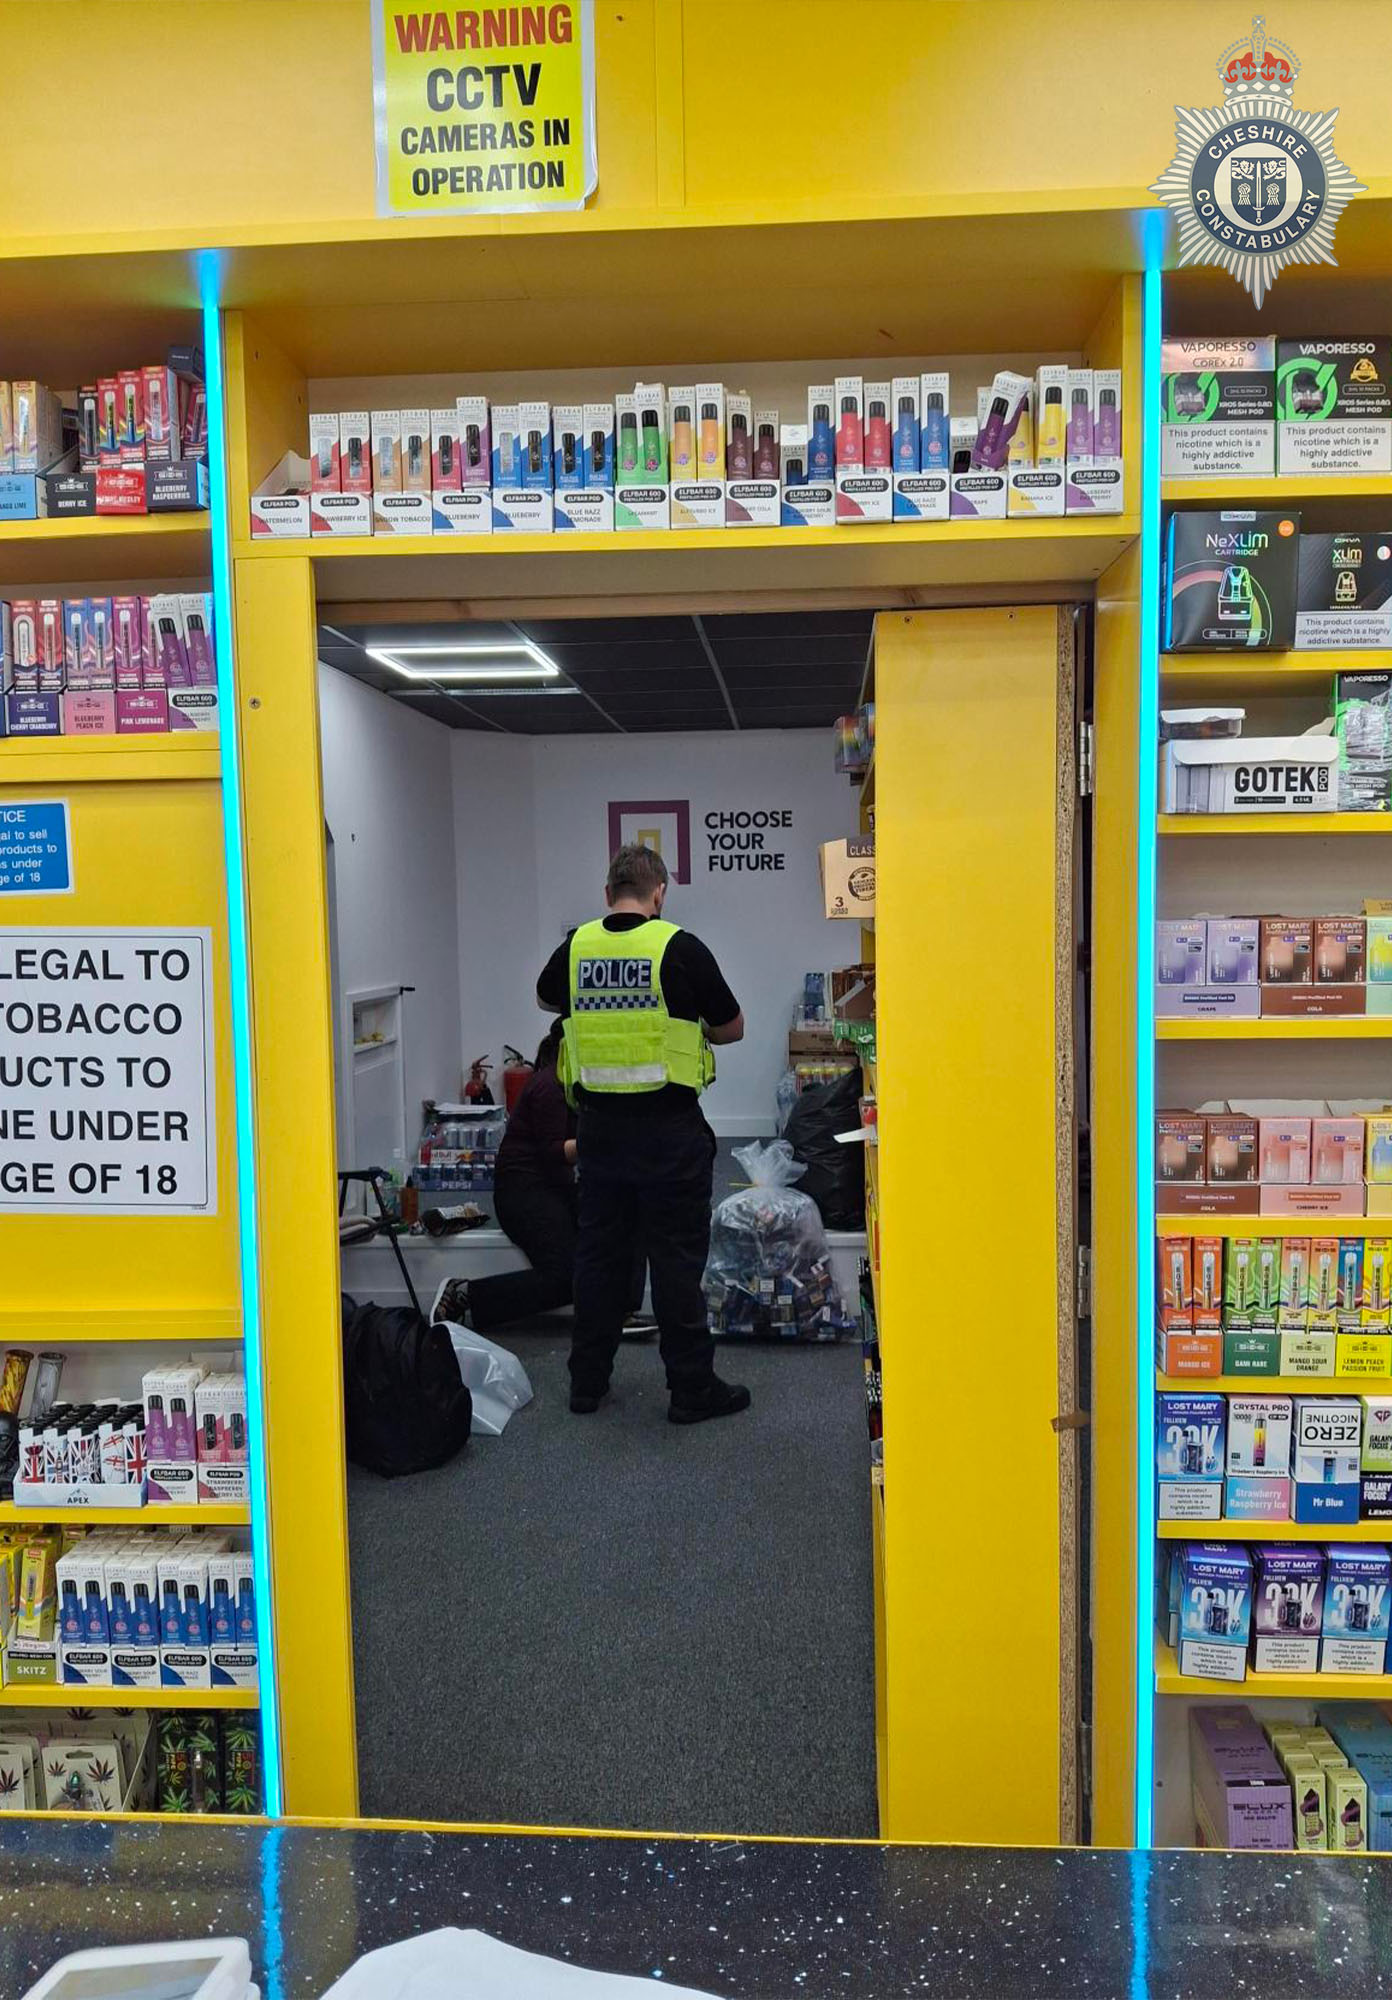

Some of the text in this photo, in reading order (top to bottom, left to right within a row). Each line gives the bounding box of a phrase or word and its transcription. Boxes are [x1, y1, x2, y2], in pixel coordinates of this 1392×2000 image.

[394, 4, 572, 53] WARNING
[427, 63, 541, 112] CCTV
[401, 118, 570, 155] CAMERAS IN
[412, 161, 565, 196] OPERATION
[1181, 341, 1256, 353] VAPORESSO
[1299, 342, 1375, 356] VAPORESSO
[1230, 357, 1244, 367] 2.0
[1170, 427, 1268, 438] This product contains
[1309, 427, 1345, 437] product
[1348, 425, 1386, 434] contains
[1176, 439, 1212, 447] nicotine
[1215, 438, 1242, 447] which
[1245, 438, 1253, 446] is
[1293, 437, 1331, 446] nicotine
[1333, 436, 1361, 445] which
[1362, 436, 1371, 444] is
[1182, 448, 1255, 460] highly addictive
[1300, 447, 1372, 458] highly addictive
[1193, 460, 1243, 469] substance.
[1311, 458, 1360, 468] substance.
[1017, 475, 1056, 484] ELFBAR 600
[1075, 472, 1114, 481] ELFBAR 600
[845, 479, 883, 489] ELFBAR 600
[902, 480, 941, 489] ELFBAR 600
[960, 480, 985, 488] ELFBAR
[623, 489, 647, 498] ELFBAR
[679, 488, 703, 496] ELFBAR
[734, 486, 758, 495] ELFBAR
[789, 491, 813, 499] ELFBAR
[1215, 549, 1259, 557] CARTRIDGE
[1306, 617, 1385, 628] This product contains
[1299, 628, 1329, 636] nicotine
[1330, 627, 1354, 635] which
[1355, 627, 1361, 635] is
[1369, 627, 1392, 637] highly
[1308, 636, 1381, 645] addictive substance.
[1344, 675, 1388, 683] VAPORESSO
[176, 695, 200, 703] ELFBAR
[1235, 766, 1328, 793] GOTEK POD
[705, 811, 793, 830] CHOOSE
[15, 831, 25, 841] to
[29, 828, 48, 840] sell
[708, 833, 764, 851] YOUR
[47, 844, 57, 853] to
[12, 857, 43, 869] under
[709, 853, 785, 872] FUTURE
[14, 872, 24, 883] of
[29, 871, 41, 883] 18
[835, 896, 844, 908] 3
[1266, 923, 1287, 931] LOST
[1319, 922, 1363, 931] LOST MARY
[135, 949, 190, 981] TO
[579, 960, 651, 991] POLICE
[0, 1002, 182, 1035] OBACCO
[117, 1056, 171, 1088] TO
[50, 1110, 189, 1142] UNDER
[69, 1162, 122, 1194] OF
[136, 1164, 178, 1195] 18
[1289, 1358, 1310, 1366] MANGO
[1369, 1364, 1385, 1372] FRUIT
[1233, 1404, 1269, 1412] CRYSTAL
[1306, 1414, 1358, 1423] NICOTINE
[1305, 1426, 1357, 1440] ZERO
[1236, 1488, 1281, 1500] Strawberry
[1364, 1491, 1387, 1501] FOCUS
[67, 1496, 90, 1504] APEX
[1313, 1498, 1343, 1507] Mr Blue
[1230, 1499, 1287, 1512] Raspberry Ice
[1293, 1561, 1318, 1569] MARY
[1335, 1562, 1386, 1571] LOST MARY
[1219, 1567, 1244, 1576] MARY
[17, 1666, 46, 1675] SKITZ
